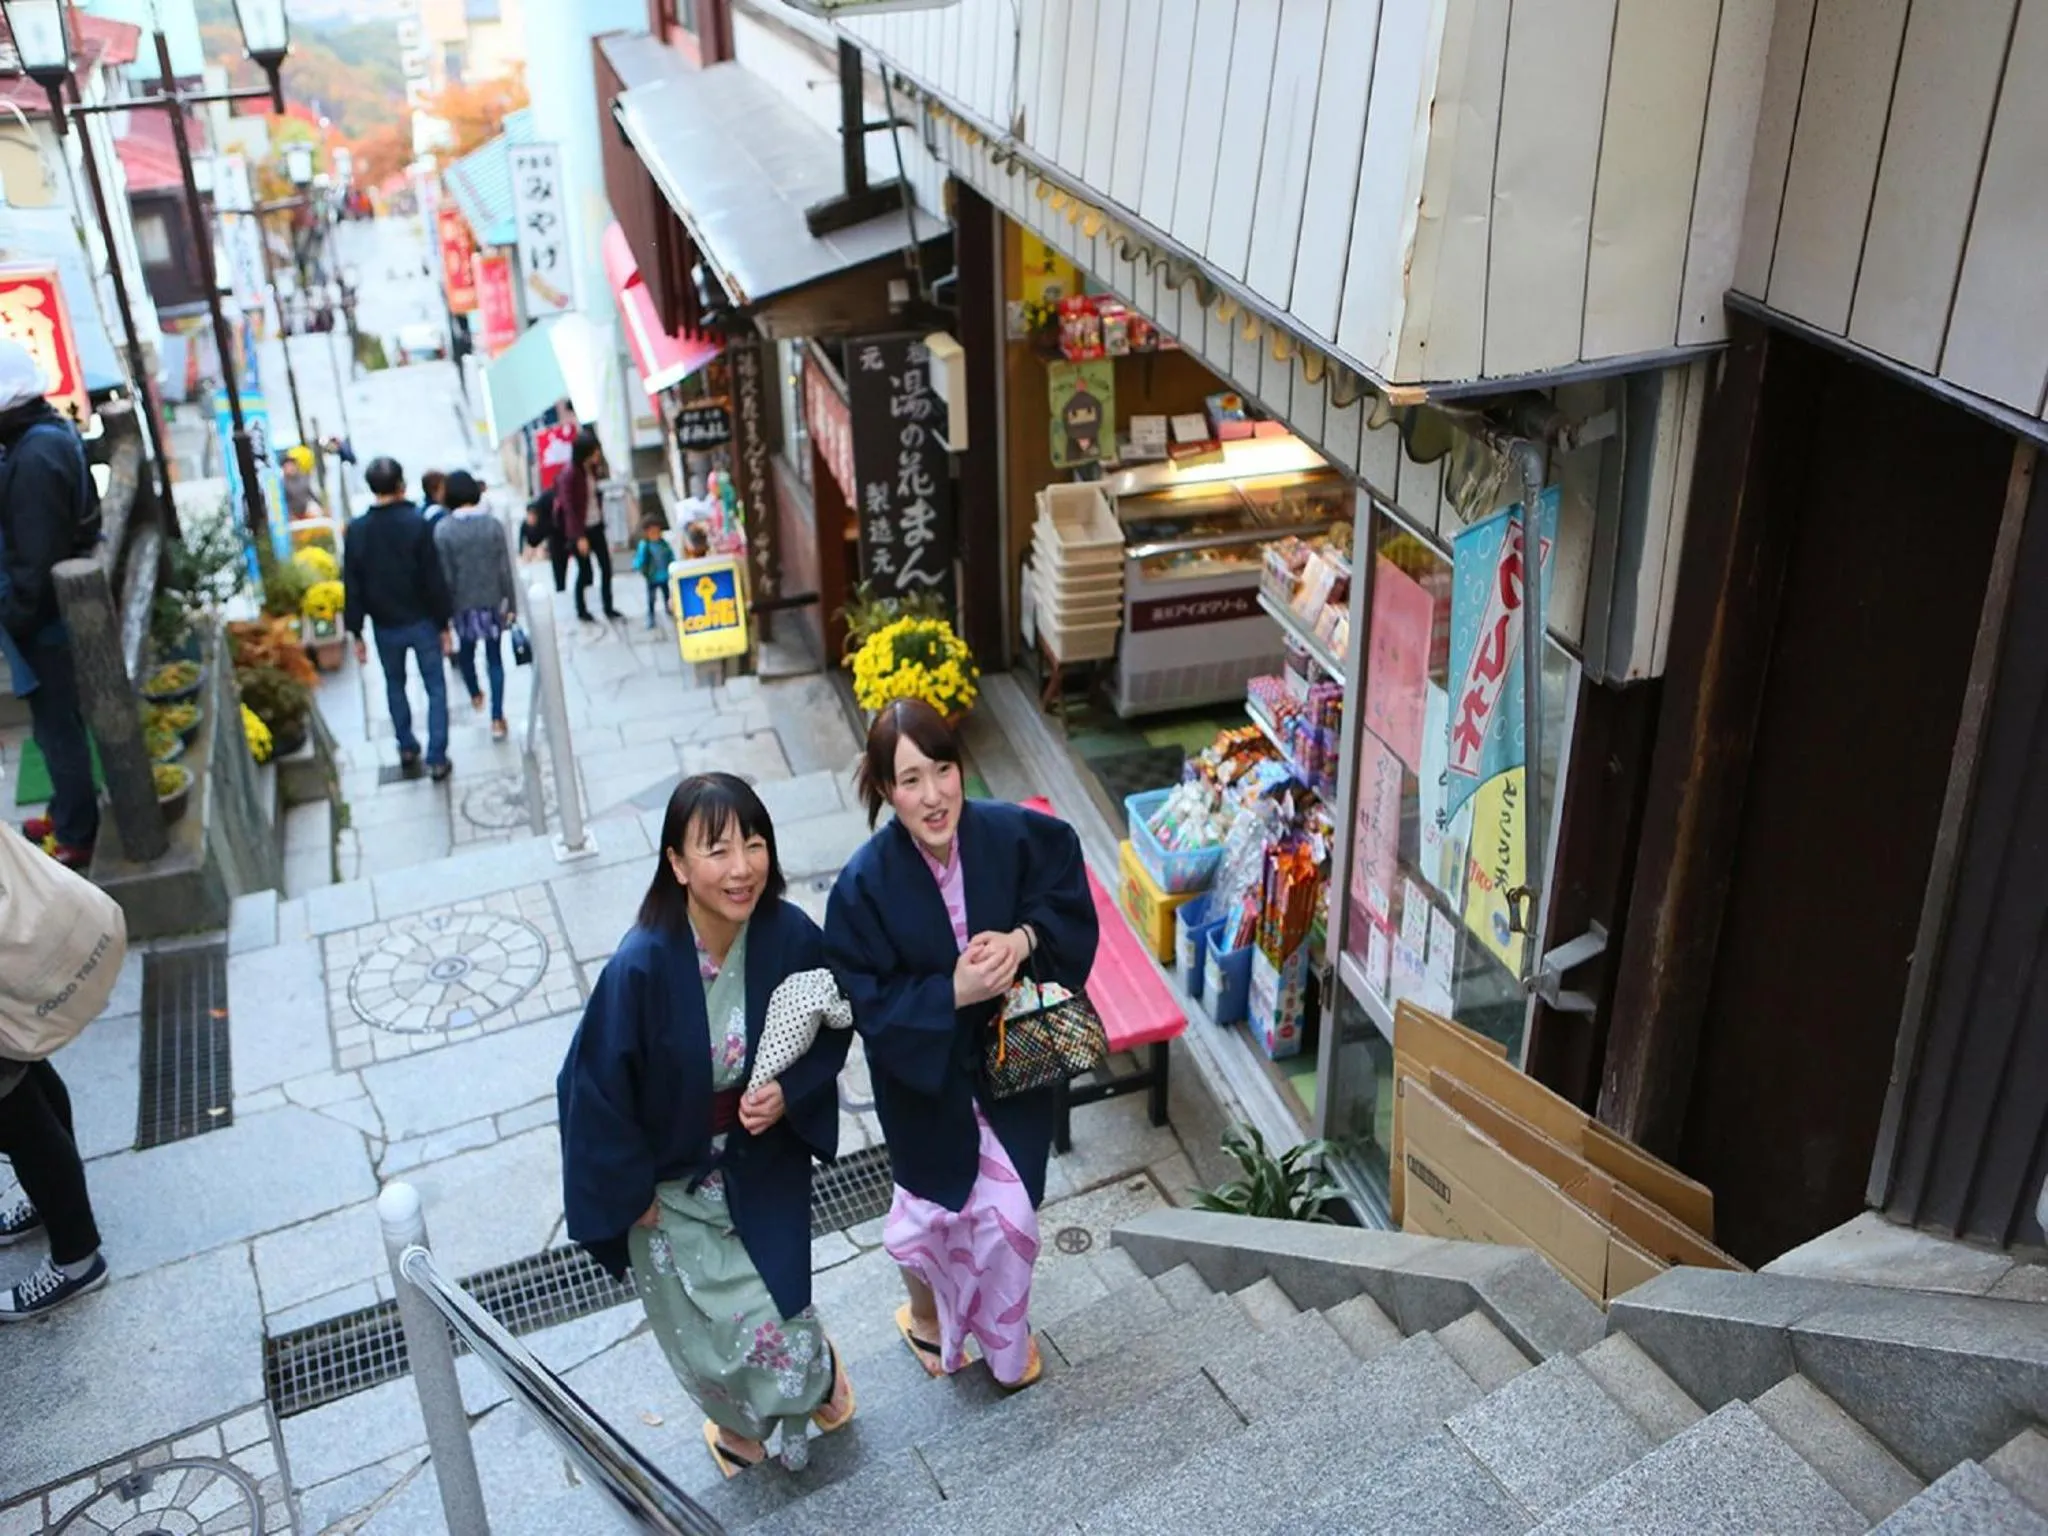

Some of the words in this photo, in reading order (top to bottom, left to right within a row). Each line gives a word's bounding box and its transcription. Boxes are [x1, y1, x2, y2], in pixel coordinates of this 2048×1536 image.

[865, 481, 897, 575] 製造元
[888, 368, 946, 605] 湯の花まん
